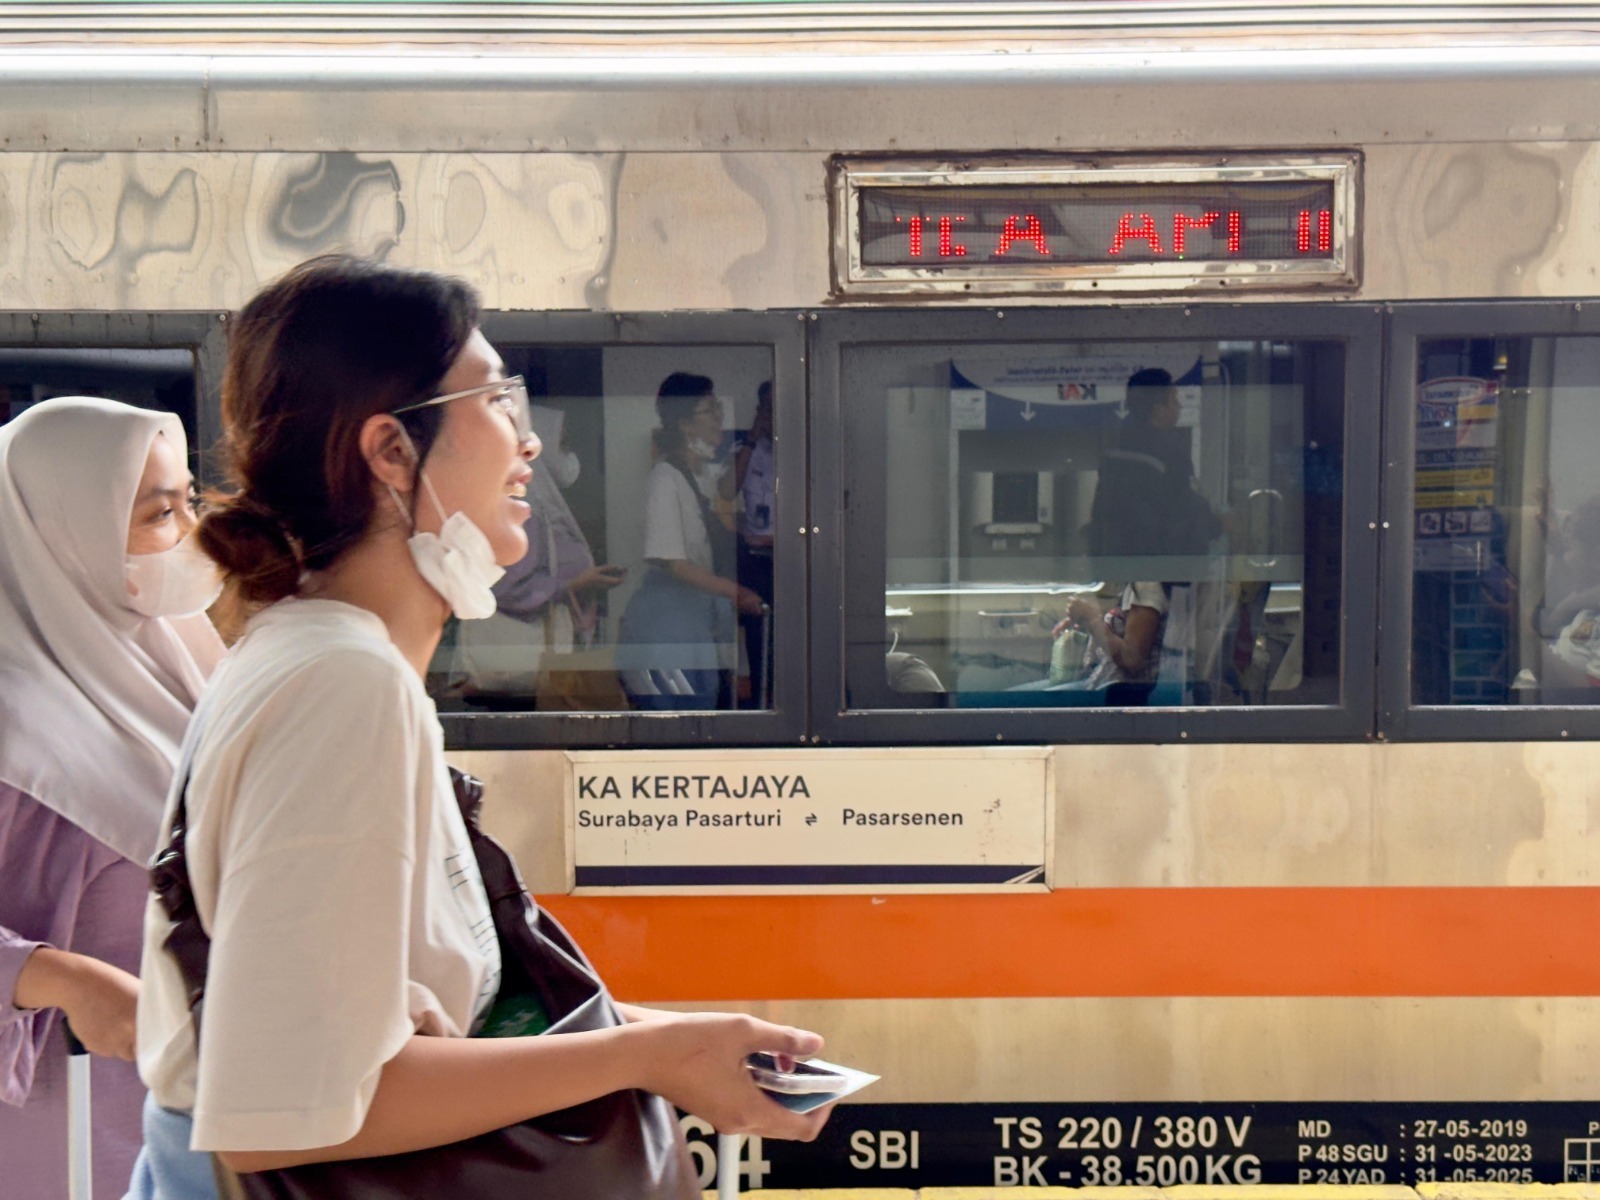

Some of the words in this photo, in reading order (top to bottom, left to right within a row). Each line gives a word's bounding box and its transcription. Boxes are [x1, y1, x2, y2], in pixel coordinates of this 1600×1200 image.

[578, 776, 622, 799] KA
[632, 775, 811, 799] KERTAJAYA
[578, 809, 678, 831] Surabaya
[686, 809, 781, 827] Pasarturi
[842, 808, 964, 827] Pasarsenen
[993, 1116, 1043, 1149] TS
[1057, 1116, 1122, 1149] 220
[1153, 1115, 1218, 1149] 380
[1224, 1115, 1252, 1148] V
[1298, 1120, 1331, 1138] MD
[1413, 1119, 1528, 1139] 27-05-2019
[849, 1129, 920, 1170] SBI
[993, 1155, 1048, 1186] BK
